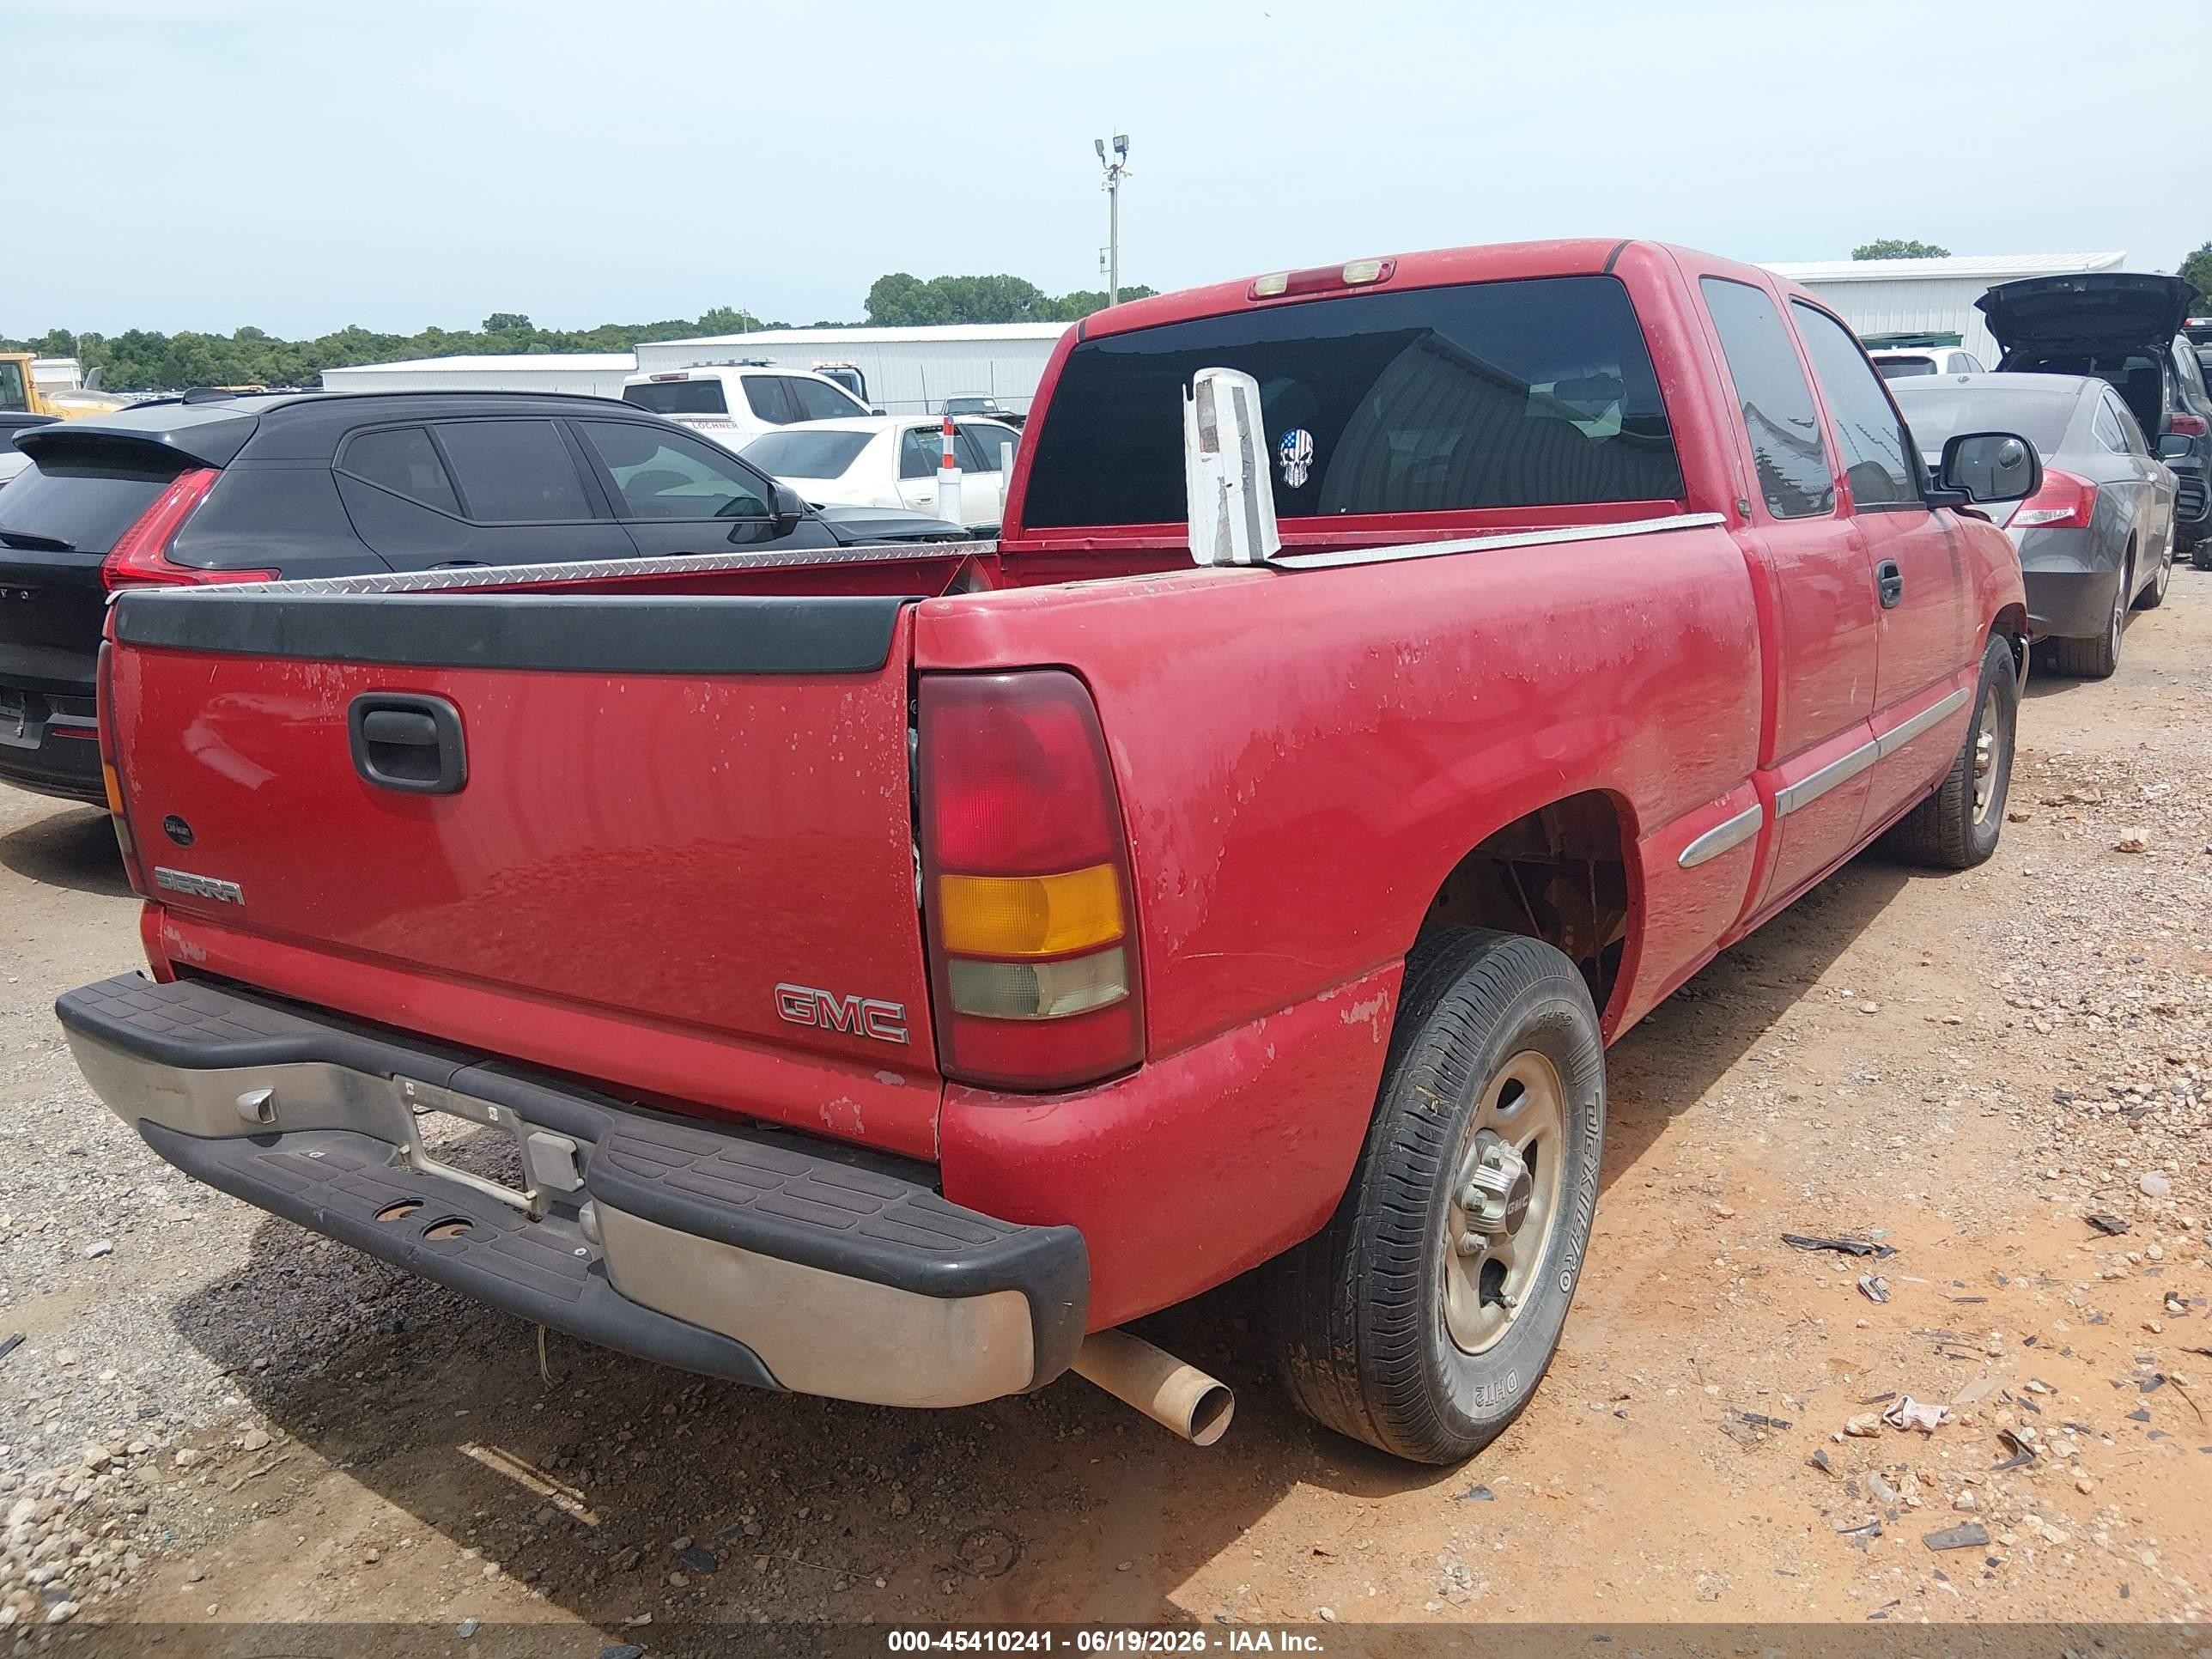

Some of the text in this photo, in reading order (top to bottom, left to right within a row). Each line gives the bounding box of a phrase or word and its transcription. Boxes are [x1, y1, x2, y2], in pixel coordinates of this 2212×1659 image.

[154, 866, 246, 906] SIERRA
[775, 982, 910, 1045] GMC
[1507, 1194, 1529, 1216] GMC
[1558, 1091, 1601, 1294] DEXTERO
[1474, 1369, 1519, 1407] DHT2
